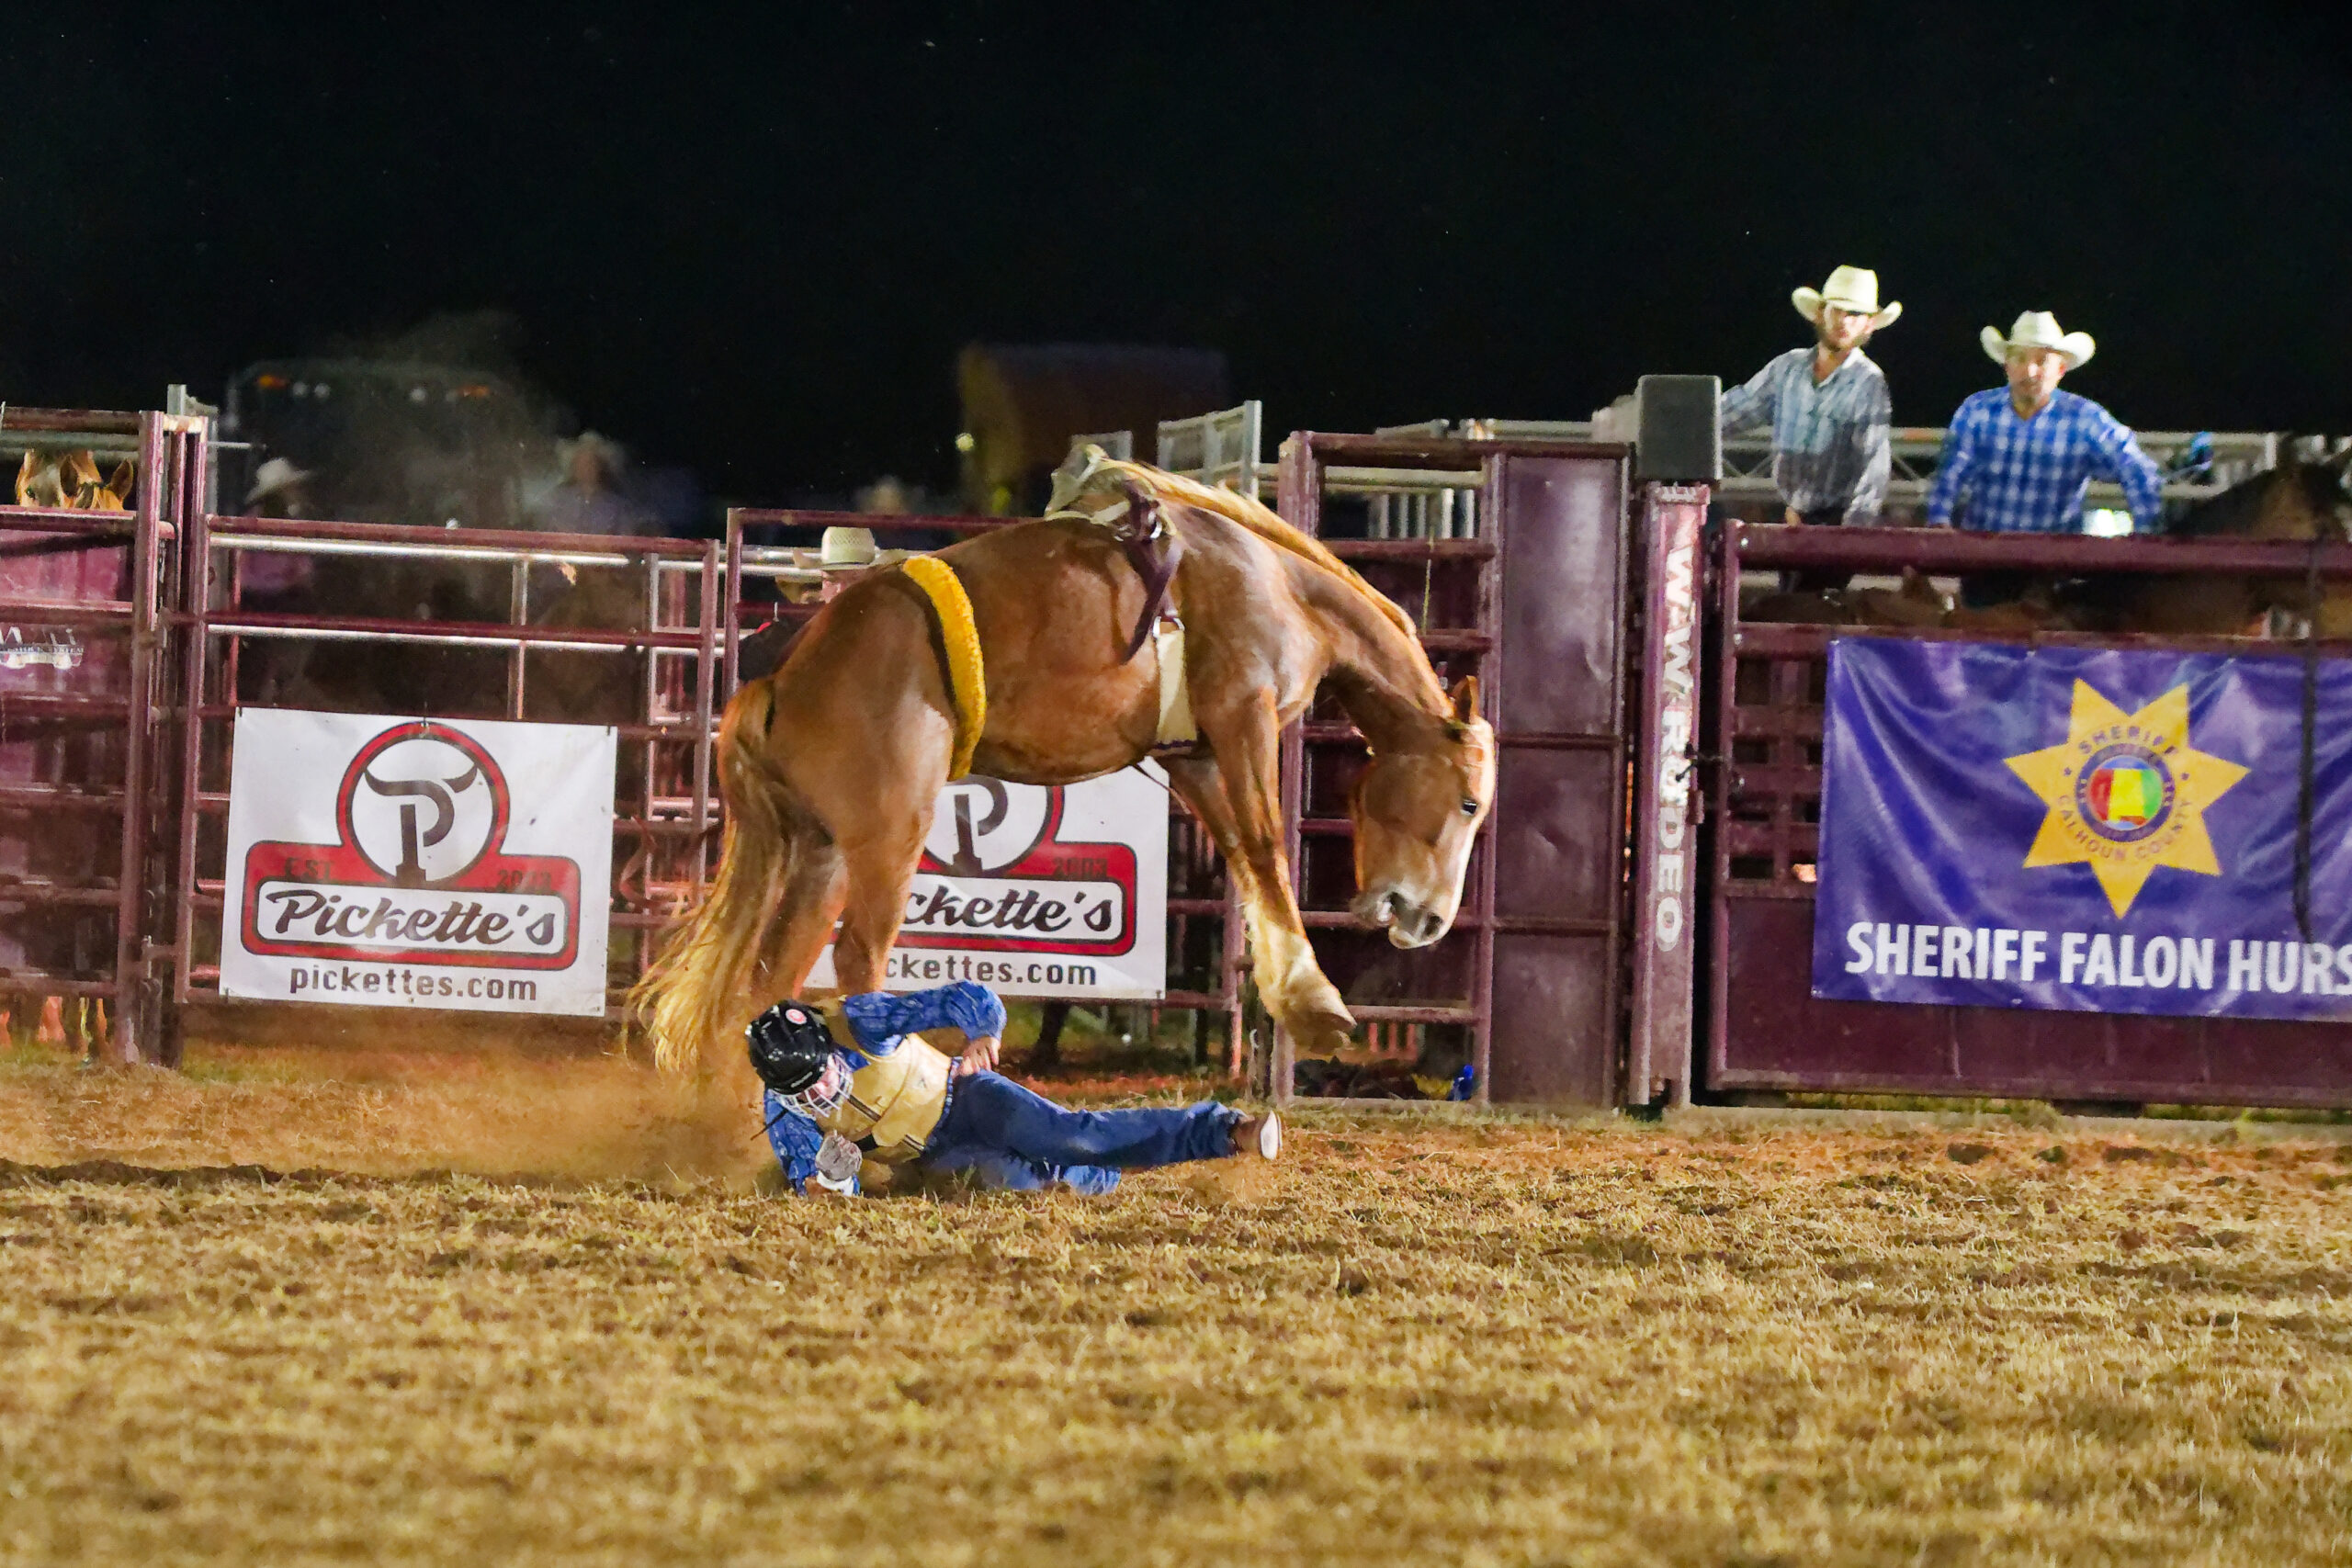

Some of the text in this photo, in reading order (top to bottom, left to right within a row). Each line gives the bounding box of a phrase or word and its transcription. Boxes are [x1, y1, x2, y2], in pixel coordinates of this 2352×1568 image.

[1657, 705, 1691, 952] RODEO
[266, 889, 555, 945] Pickette's
[905, 885, 1114, 932] ckette's
[886, 953, 1097, 986] ckettes.com
[1845, 921, 2048, 982] SHERIFF
[2060, 932, 2215, 990] FALON
[289, 965, 537, 1000] pickettes.com
